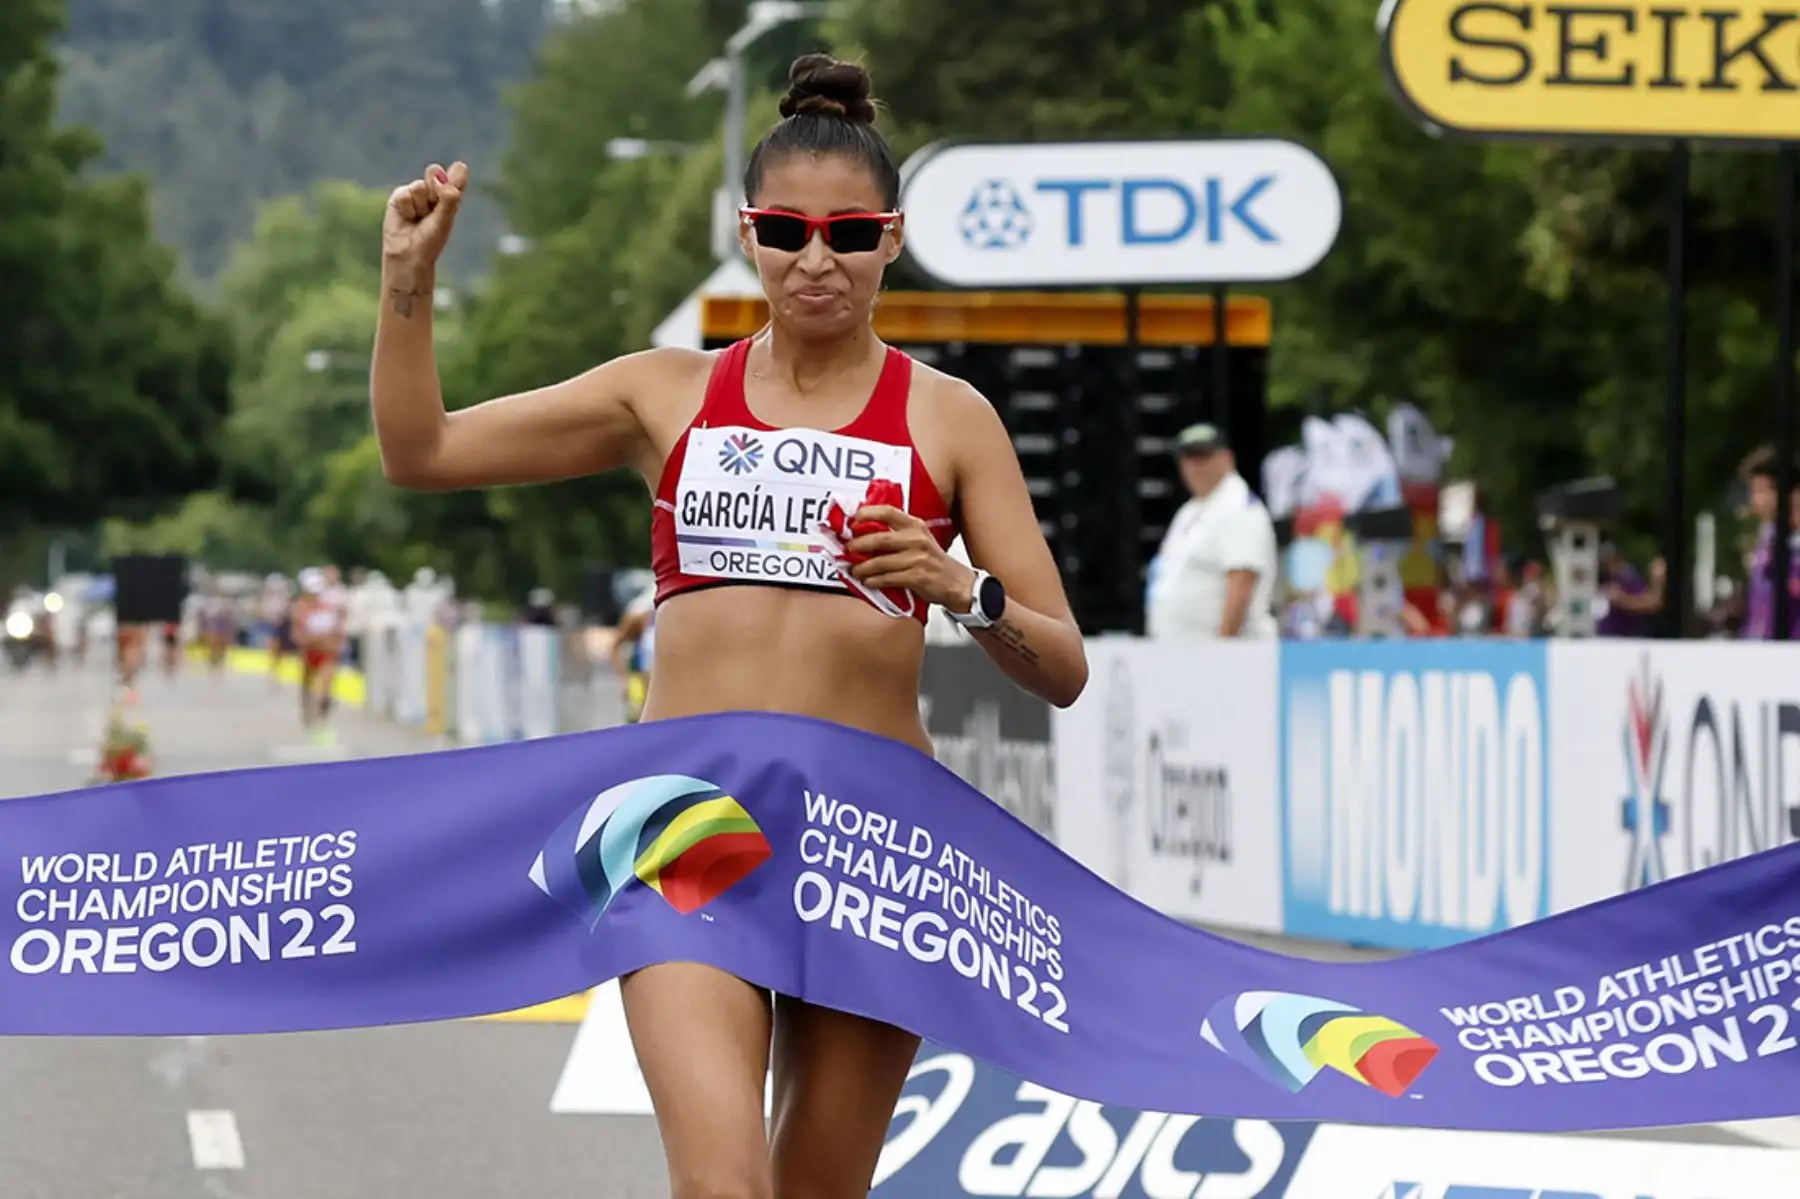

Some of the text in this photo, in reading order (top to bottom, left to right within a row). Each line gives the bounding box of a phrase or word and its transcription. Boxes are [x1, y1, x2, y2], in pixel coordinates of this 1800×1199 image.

[1447, 2, 1800, 92] SEIK
[1036, 174, 1282, 247] TDK
[773, 438, 876, 482] QNB
[682, 485, 776, 533] GARCÍA
[1329, 668, 1543, 932] MONDO
[16, 864, 353, 922] CHAMPIONSHIPS
[21, 830, 357, 884] WORLD ATHLETICS
[801, 790, 1062, 946] WORLD ATHLETICS
[800, 829, 1064, 981] CHAMPIONSHIPS
[794, 870, 1069, 1033] OREGON22
[1441, 916, 1800, 1027] WORLD ATHLETICS
[1474, 997, 1800, 1086] OREGON2
